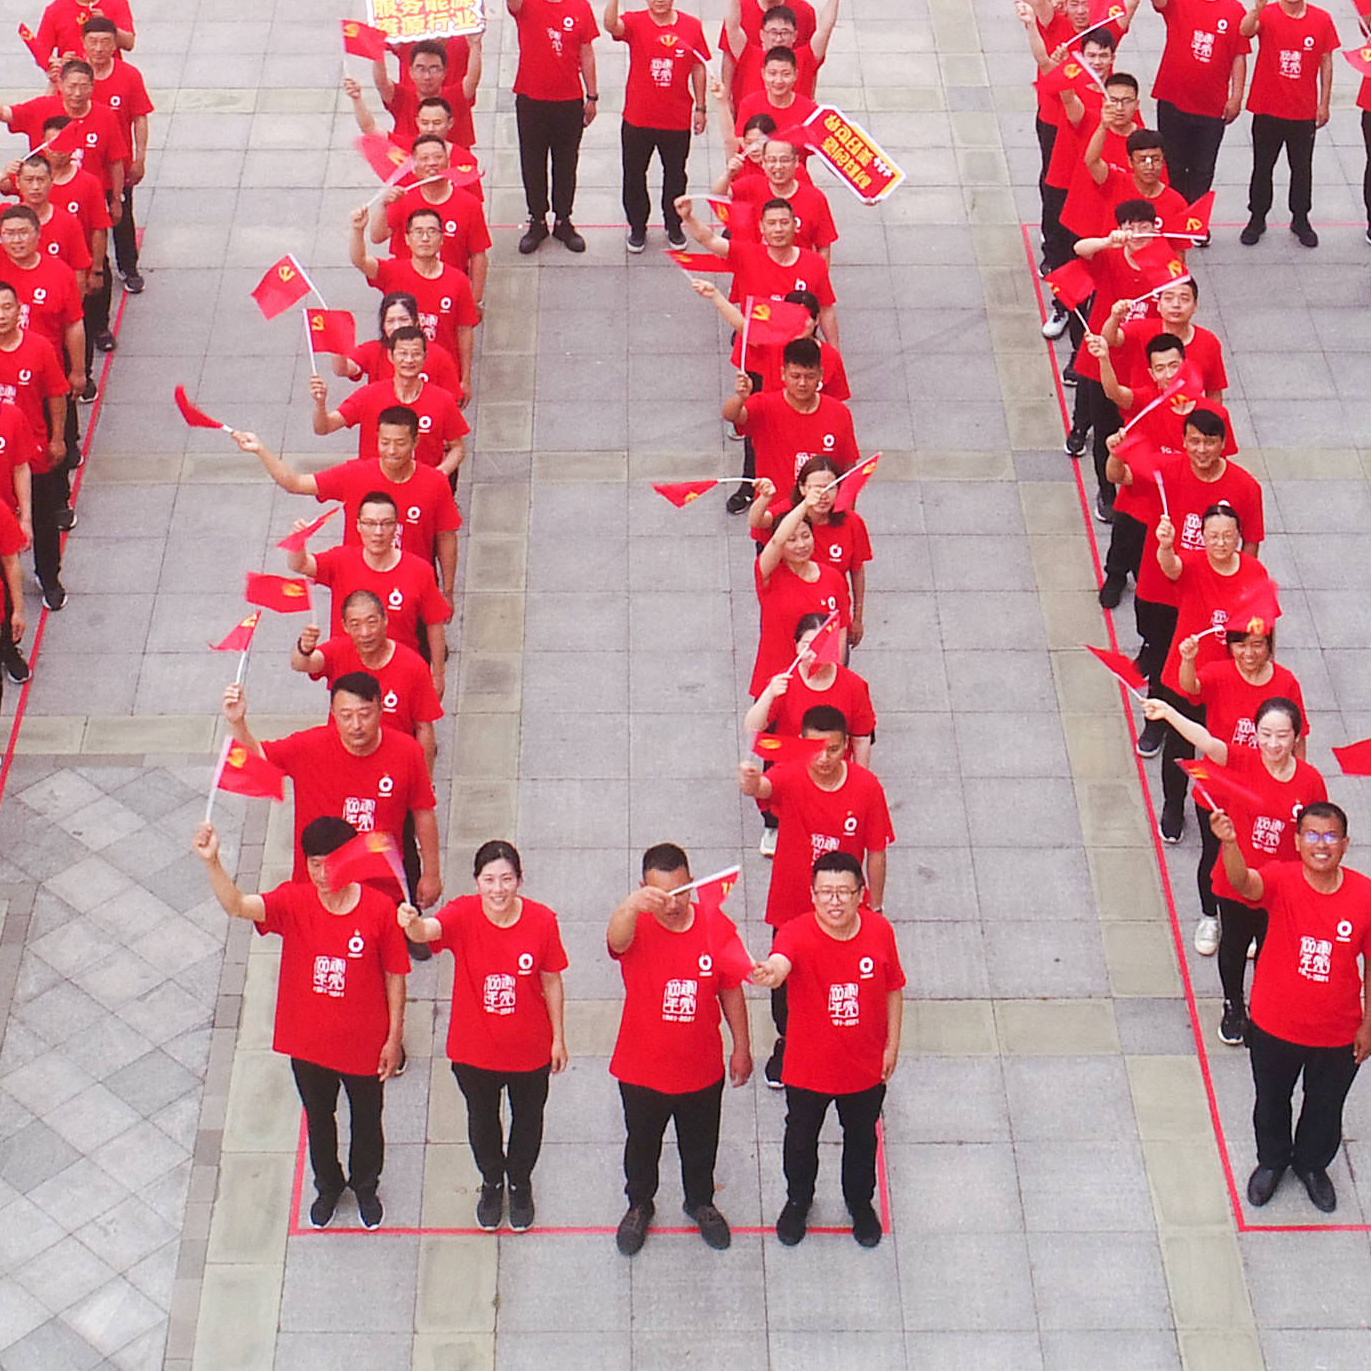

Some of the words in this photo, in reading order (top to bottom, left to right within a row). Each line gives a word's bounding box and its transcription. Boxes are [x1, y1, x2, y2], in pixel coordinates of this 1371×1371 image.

[375, 9, 480, 38] 资源行业
[821, 135, 872, 189] 材料创造
[823, 114, 875, 167] 美好世界
